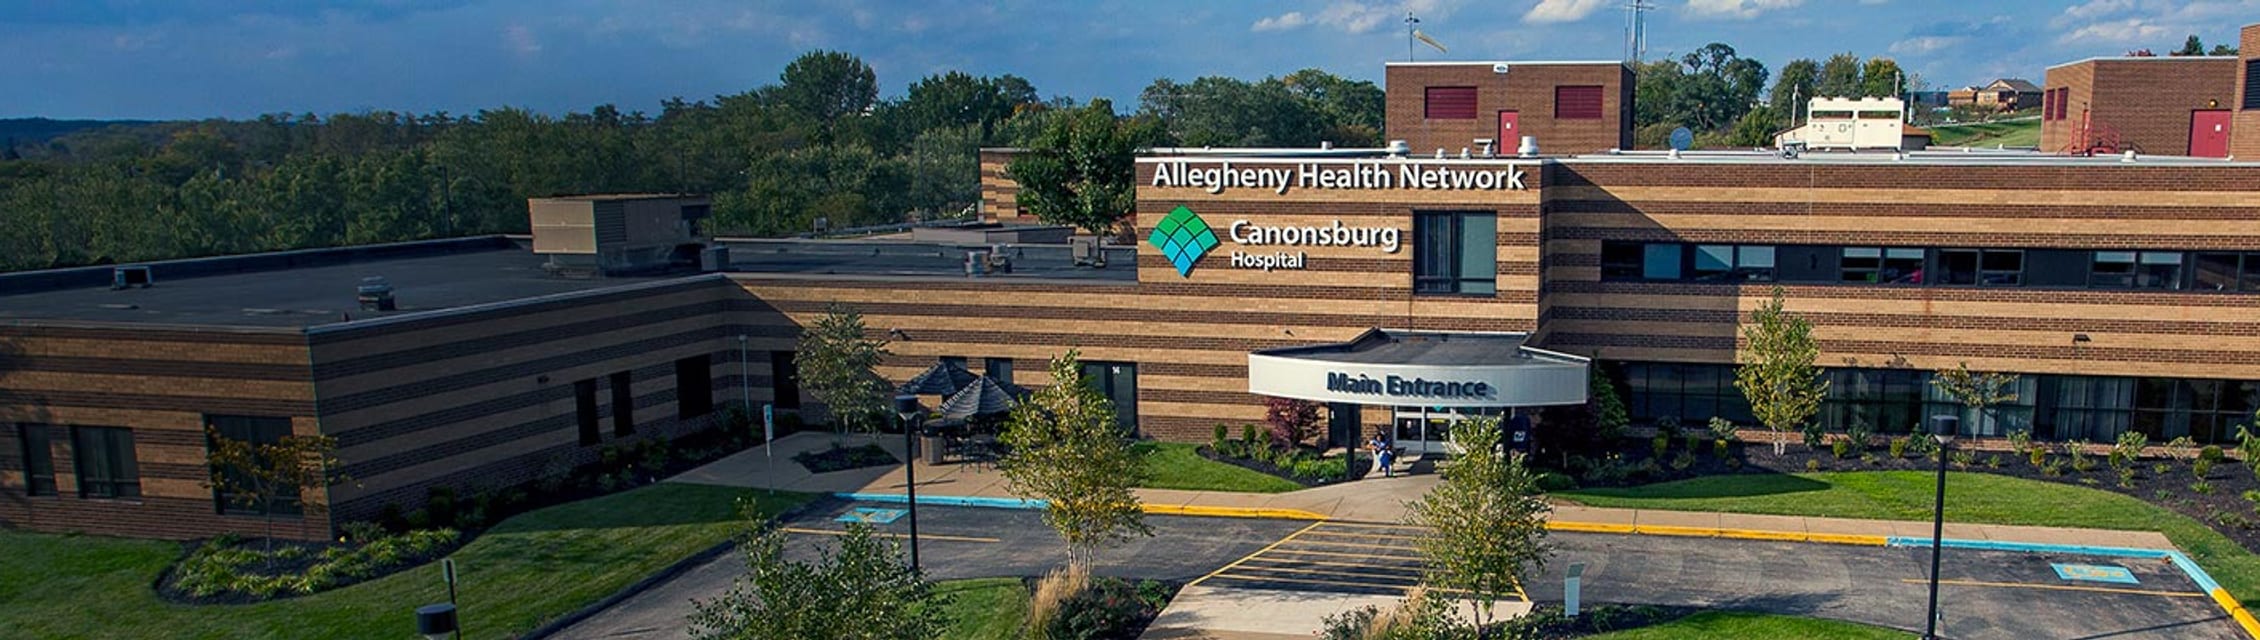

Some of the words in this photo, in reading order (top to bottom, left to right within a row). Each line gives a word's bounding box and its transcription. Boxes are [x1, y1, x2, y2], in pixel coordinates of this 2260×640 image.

[1152, 161, 1291, 194] Allegheny
[1299, 161, 1391, 188] Health
[1401, 162, 1525, 190] Network
[1229, 219, 1400, 253] Canonsburg
[1231, 251, 1304, 271] Hospital
[1327, 371, 1382, 397] Main
[1386, 375, 1489, 397] Entrance
